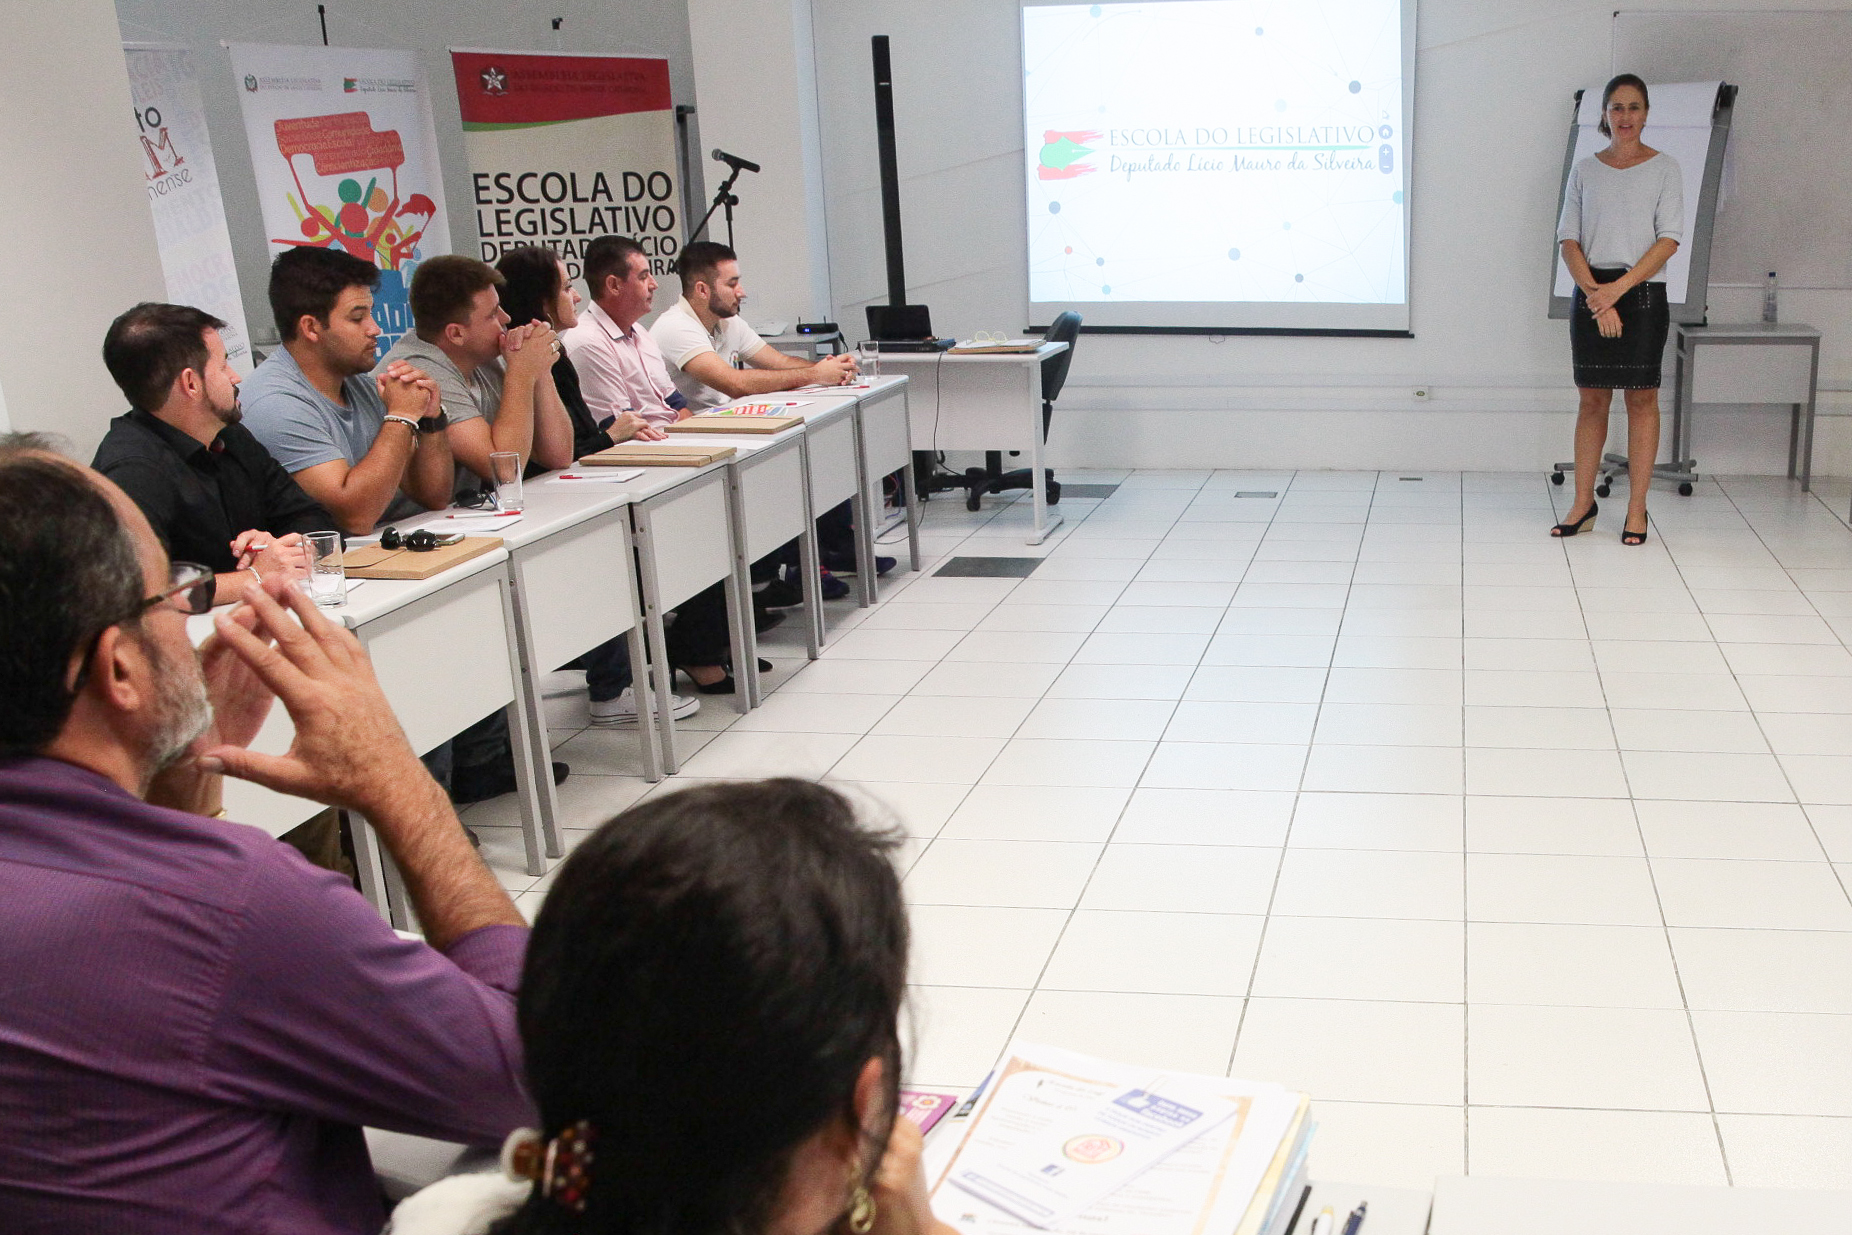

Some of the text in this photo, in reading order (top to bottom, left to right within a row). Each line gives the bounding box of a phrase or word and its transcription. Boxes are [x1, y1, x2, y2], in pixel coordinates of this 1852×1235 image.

[1110, 125, 1375, 146] ESCOLA DO LEGISLATIVO
[1110, 150, 1376, 182] Deputado Lício Mauro da Silveira
[472, 171, 673, 206] ESCOLA DO
[476, 205, 676, 238] LEGISLATIVO
